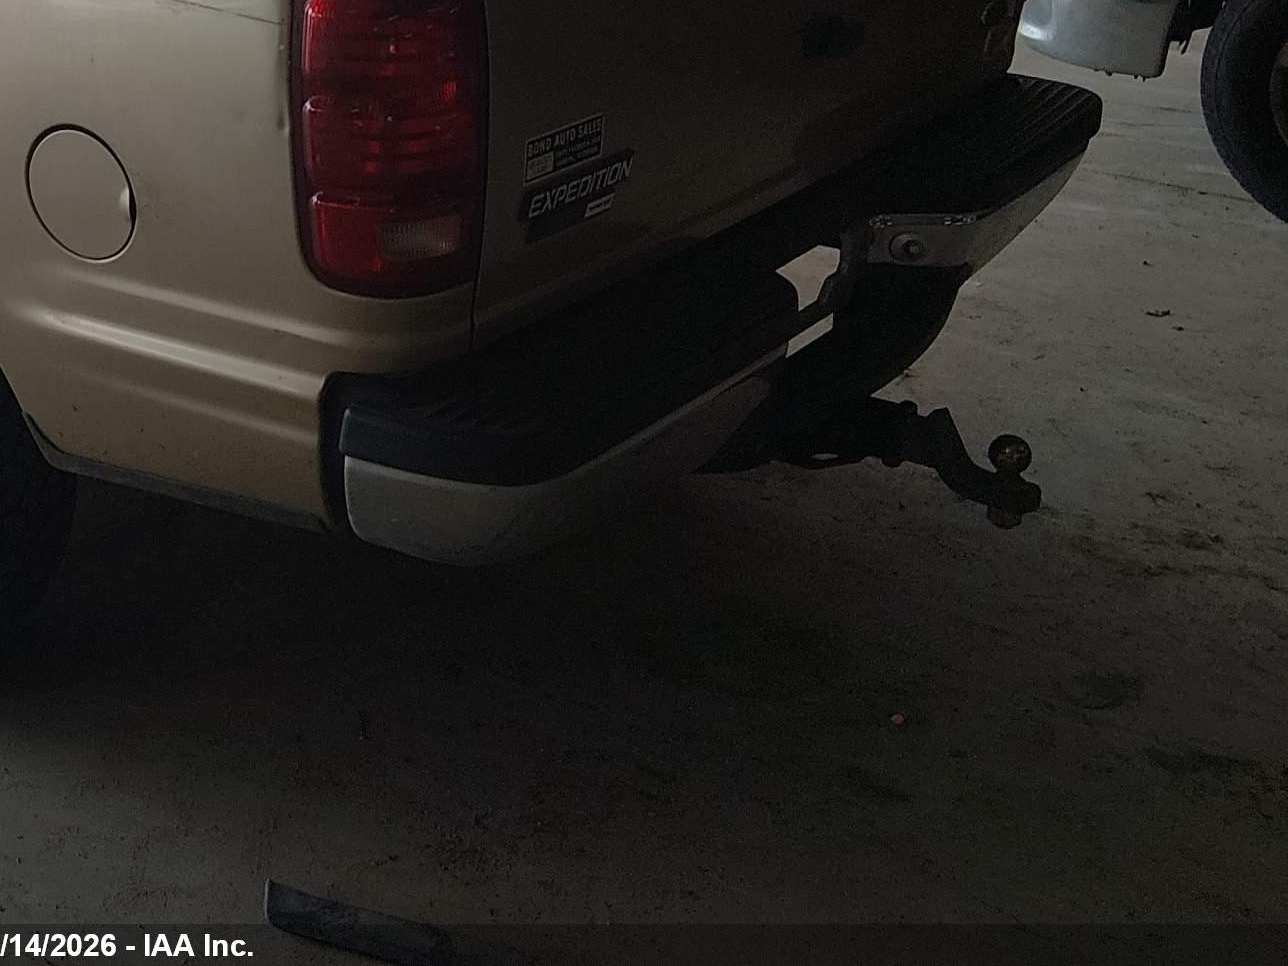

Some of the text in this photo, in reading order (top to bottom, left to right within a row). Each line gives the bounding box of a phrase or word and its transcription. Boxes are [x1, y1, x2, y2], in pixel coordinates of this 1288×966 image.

[554, 129, 576, 147] AUTO
[578, 119, 601, 138] SALES
[529, 158, 633, 218] EXPEDITION
